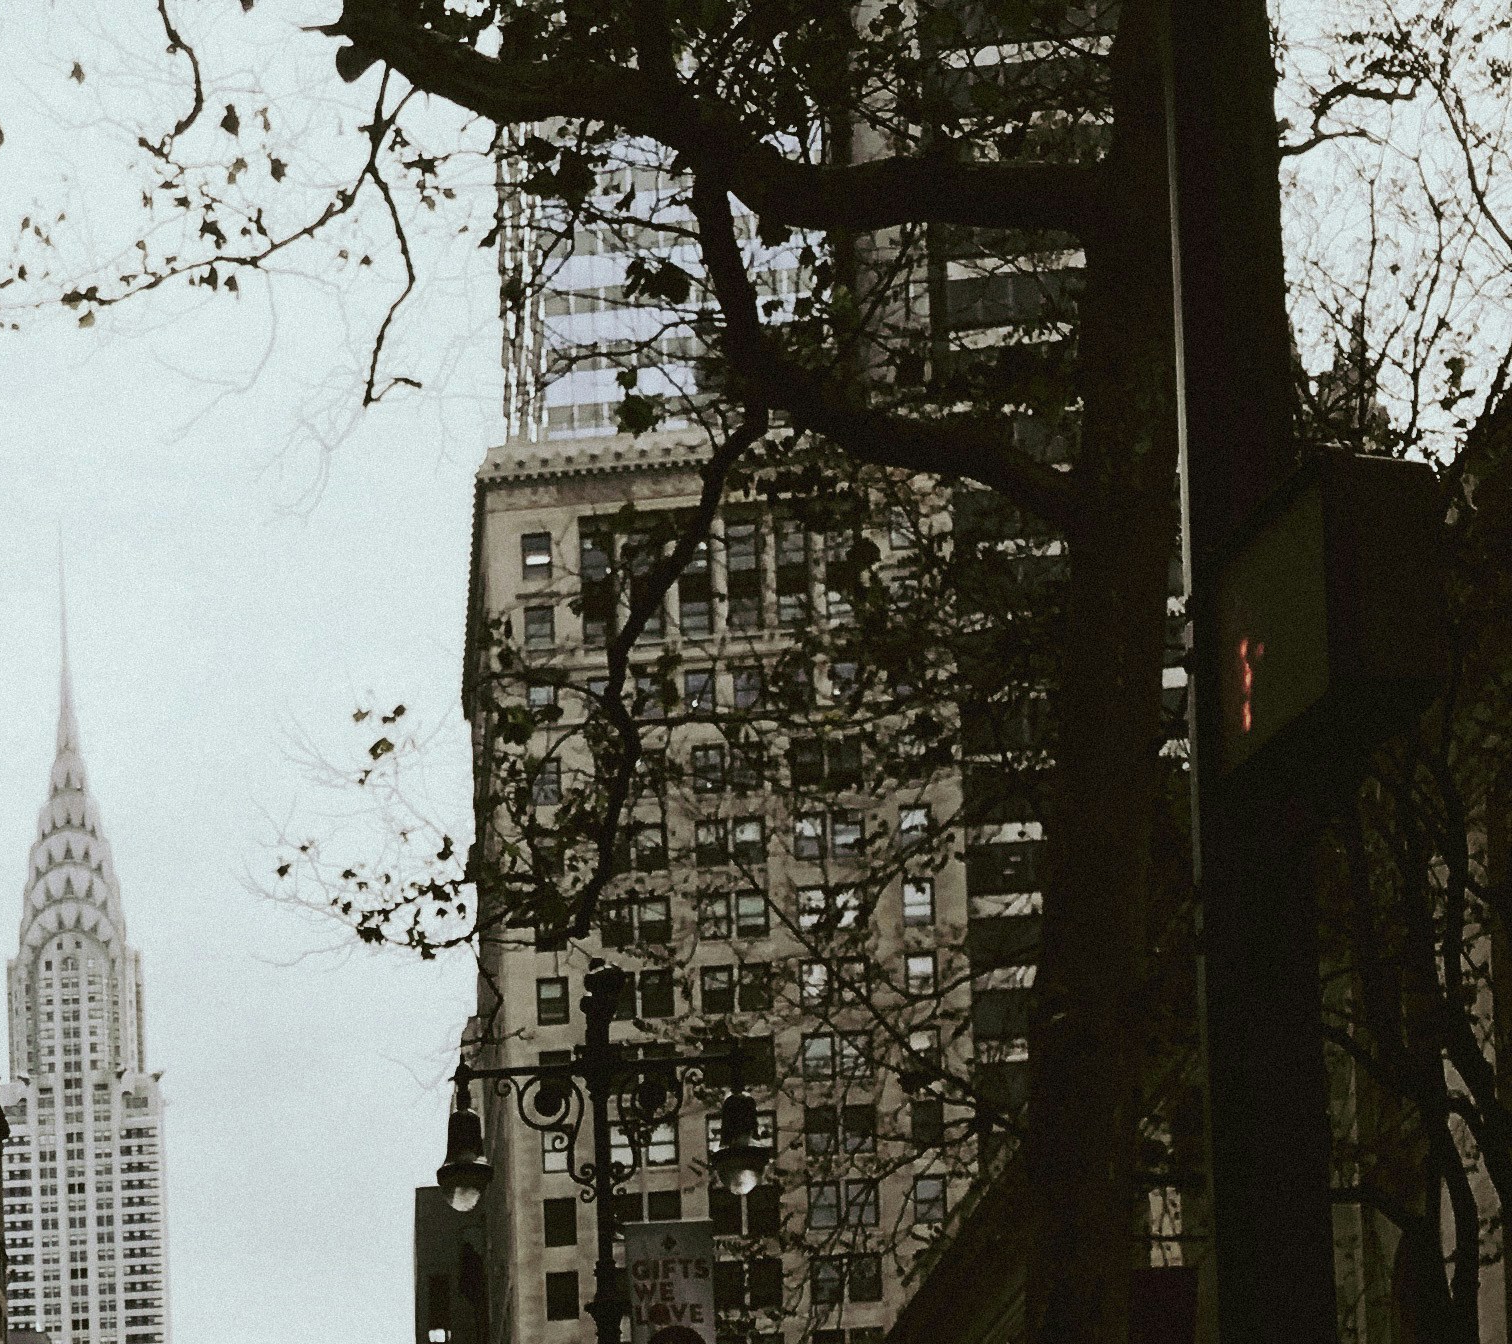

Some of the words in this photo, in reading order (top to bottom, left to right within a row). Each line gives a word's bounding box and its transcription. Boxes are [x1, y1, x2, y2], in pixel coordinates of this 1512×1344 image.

[632, 1258, 709, 1280] GIFTS
[634, 1281, 675, 1302] WE
[635, 1303, 704, 1325] LOVE
